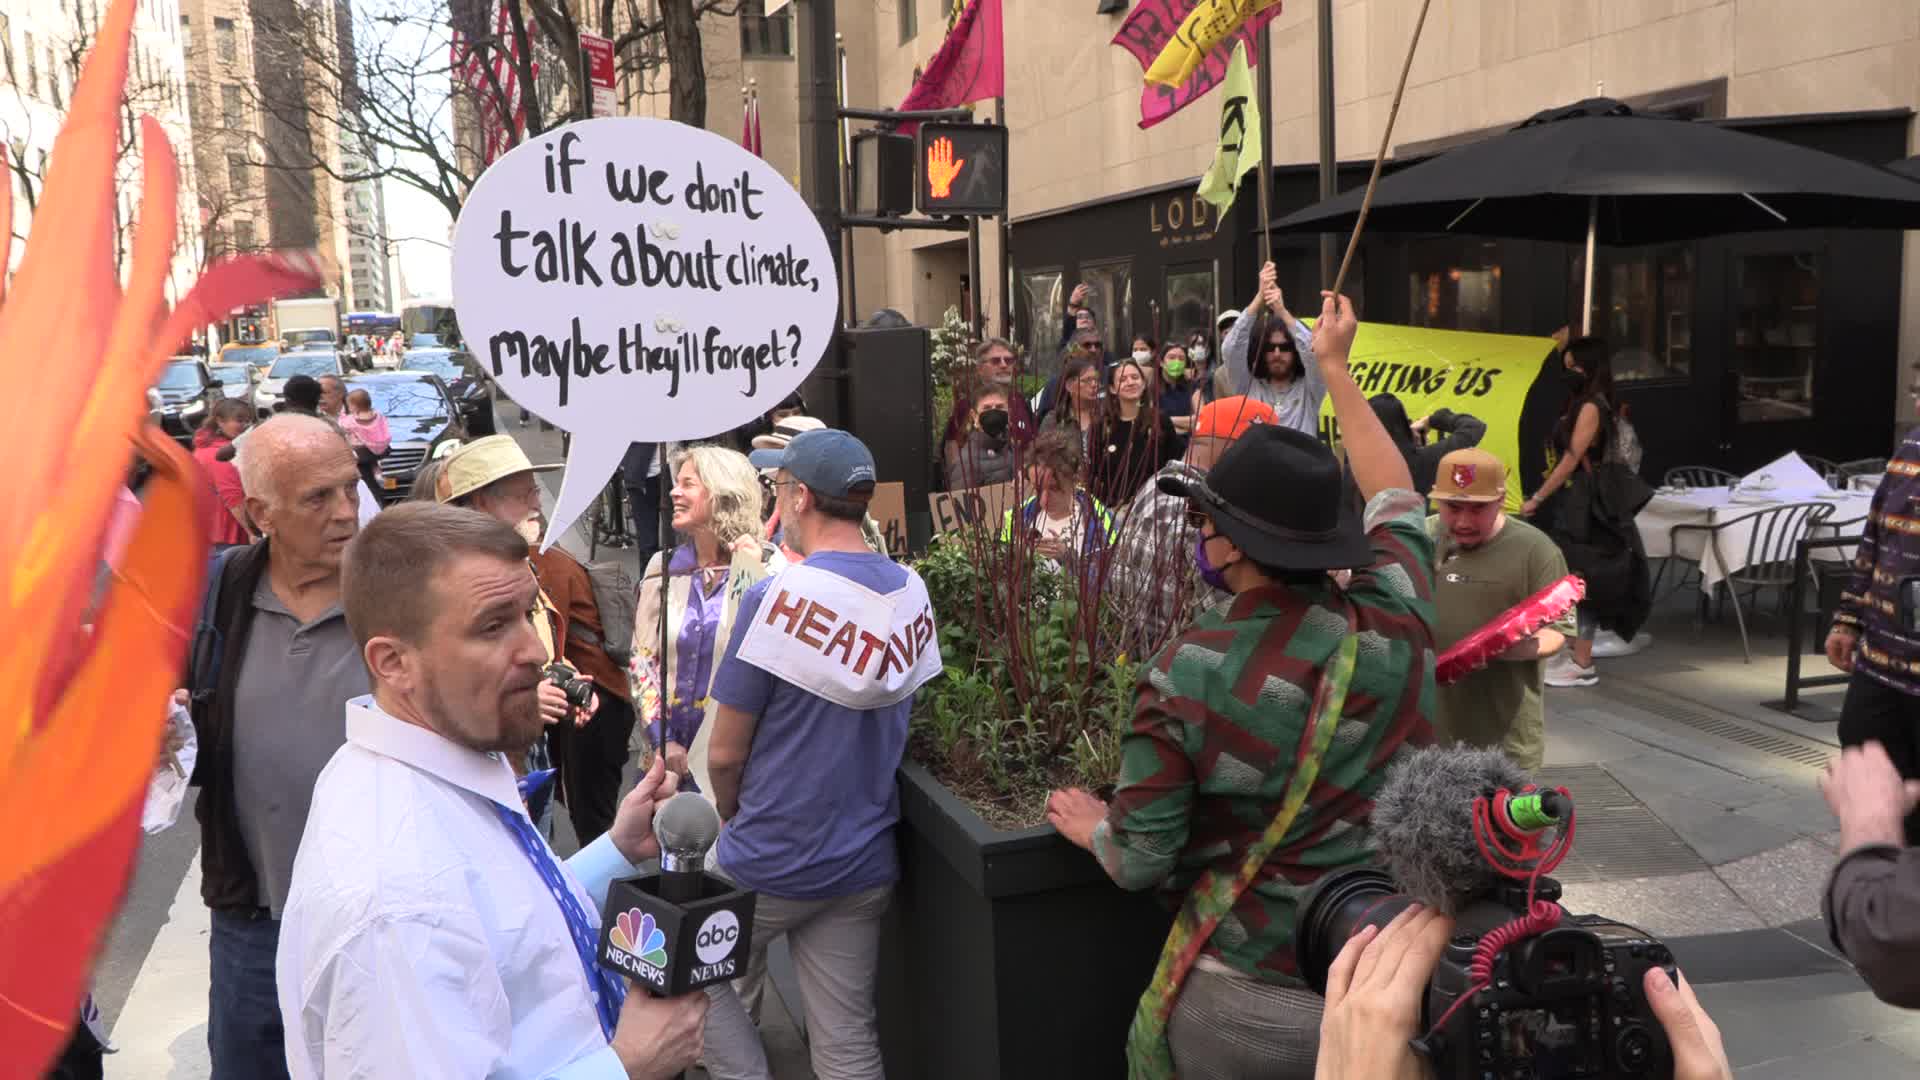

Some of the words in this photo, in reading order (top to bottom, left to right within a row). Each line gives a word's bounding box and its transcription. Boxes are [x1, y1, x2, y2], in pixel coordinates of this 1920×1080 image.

[545, 132, 586, 194] if
[606, 162, 674, 206] we
[685, 160, 764, 220] don't
[493, 210, 603, 287] talk
[610, 223, 723, 292] about
[726, 241, 819, 292] climate,
[489, 316, 616, 407] maybe
[618, 323, 700, 398] they'll
[702, 324, 801, 398] forget?
[1347, 361, 1451, 395] GHTING
[1453, 368, 1502, 397] US
[697, 924, 738, 948] abc
[605, 945, 633, 971] NBC
[631, 958, 666, 986] NEWS
[689, 959, 736, 985] NEWS
